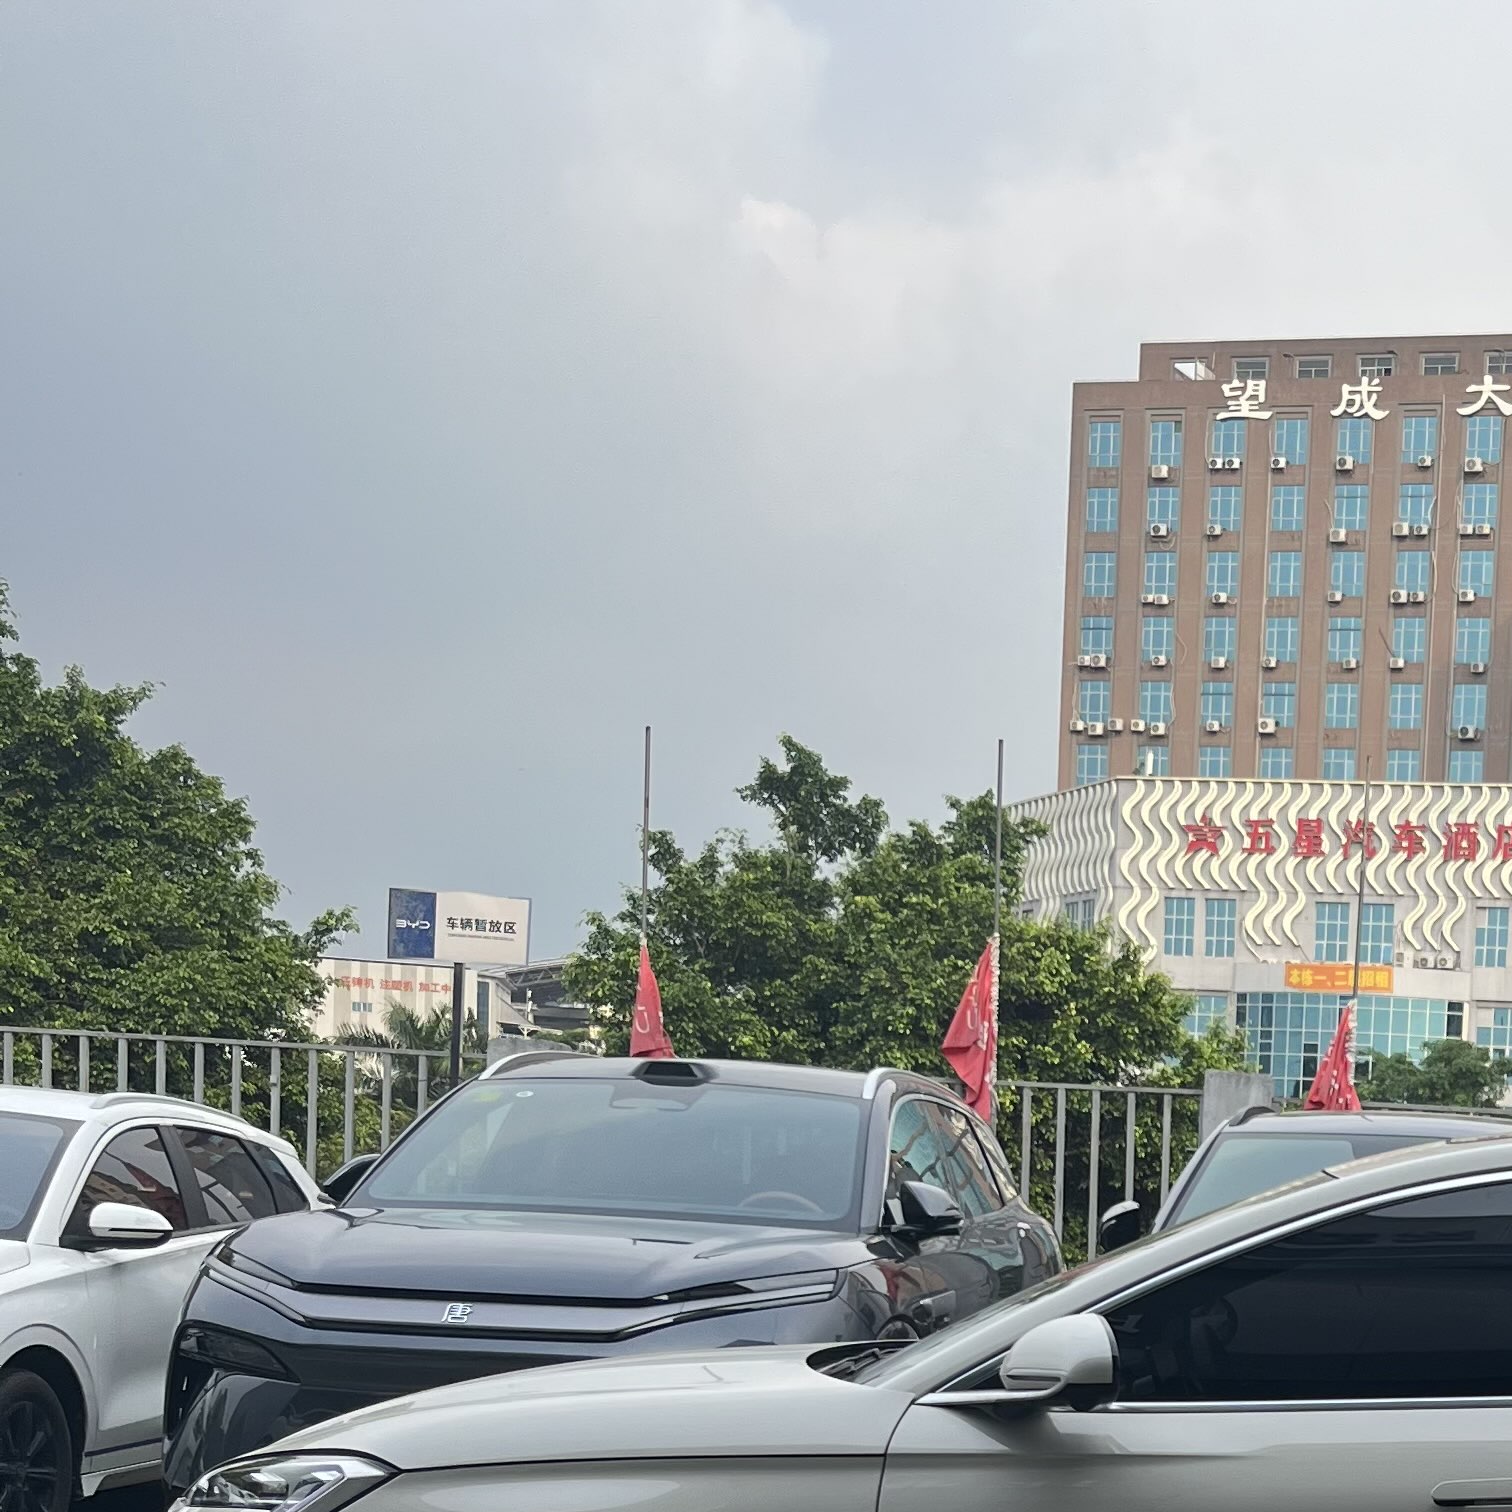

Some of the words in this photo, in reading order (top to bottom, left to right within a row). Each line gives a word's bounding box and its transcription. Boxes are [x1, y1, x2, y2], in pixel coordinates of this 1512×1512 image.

[395, 918, 432, 930] BYD
[446, 916, 517, 935] 车辆暂放区
[441, 1302, 473, 1323] 唐
